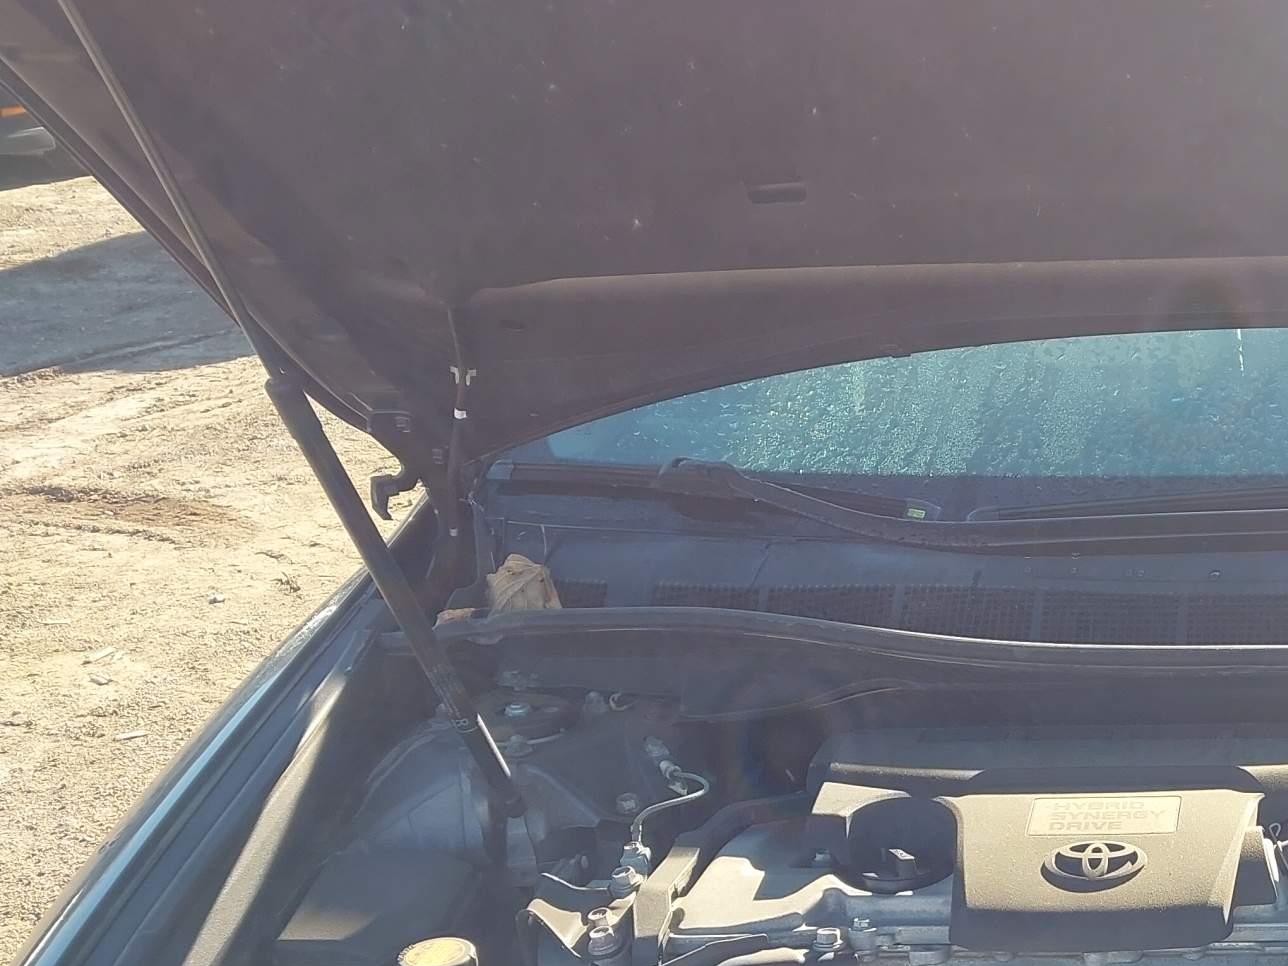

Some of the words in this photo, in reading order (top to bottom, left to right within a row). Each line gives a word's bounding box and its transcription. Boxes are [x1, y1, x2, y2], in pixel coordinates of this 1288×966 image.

[1053, 801, 1145, 810] HYBRID
[1050, 810, 1165, 821] SYNERGY
[1048, 821, 1122, 831] DRIVE
